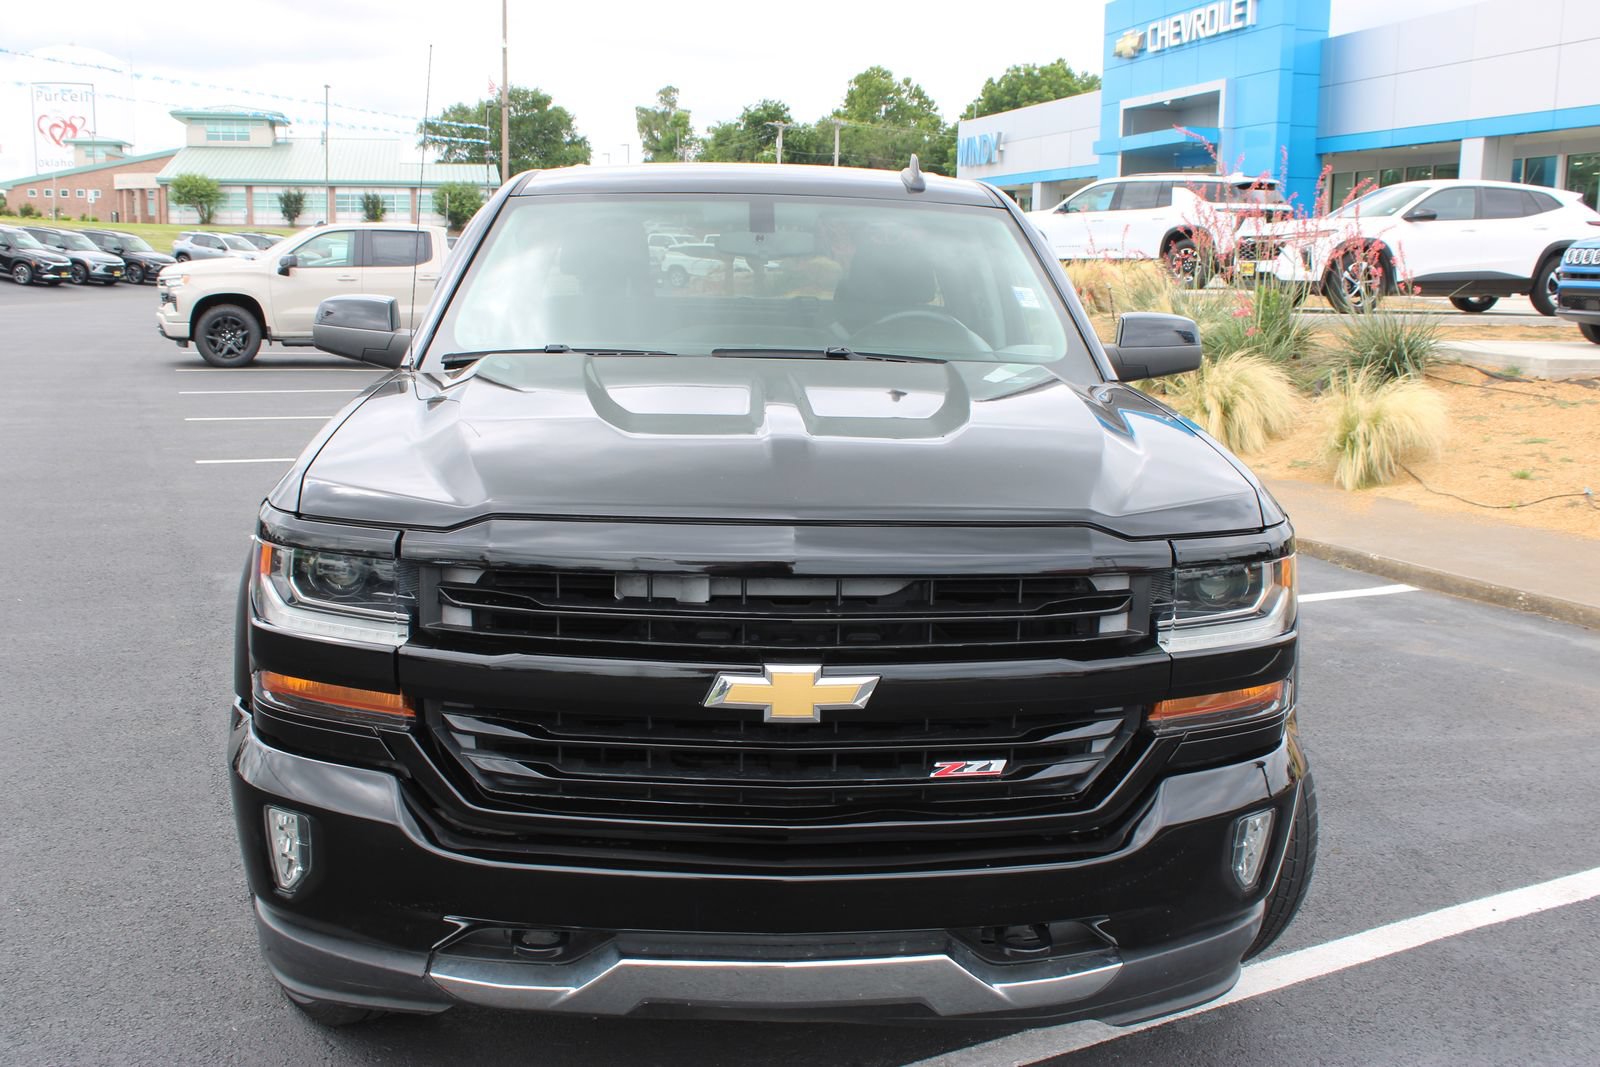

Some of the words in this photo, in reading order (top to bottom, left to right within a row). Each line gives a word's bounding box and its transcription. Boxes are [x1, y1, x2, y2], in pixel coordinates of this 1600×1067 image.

[1146, 0, 1257, 53] CHEVROLET
[35, 89, 89, 102] Purcell
[959, 131, 1002, 167] WINDY
[38, 158, 74, 168] Oklaho
[930, 759, 1007, 778] Z71
